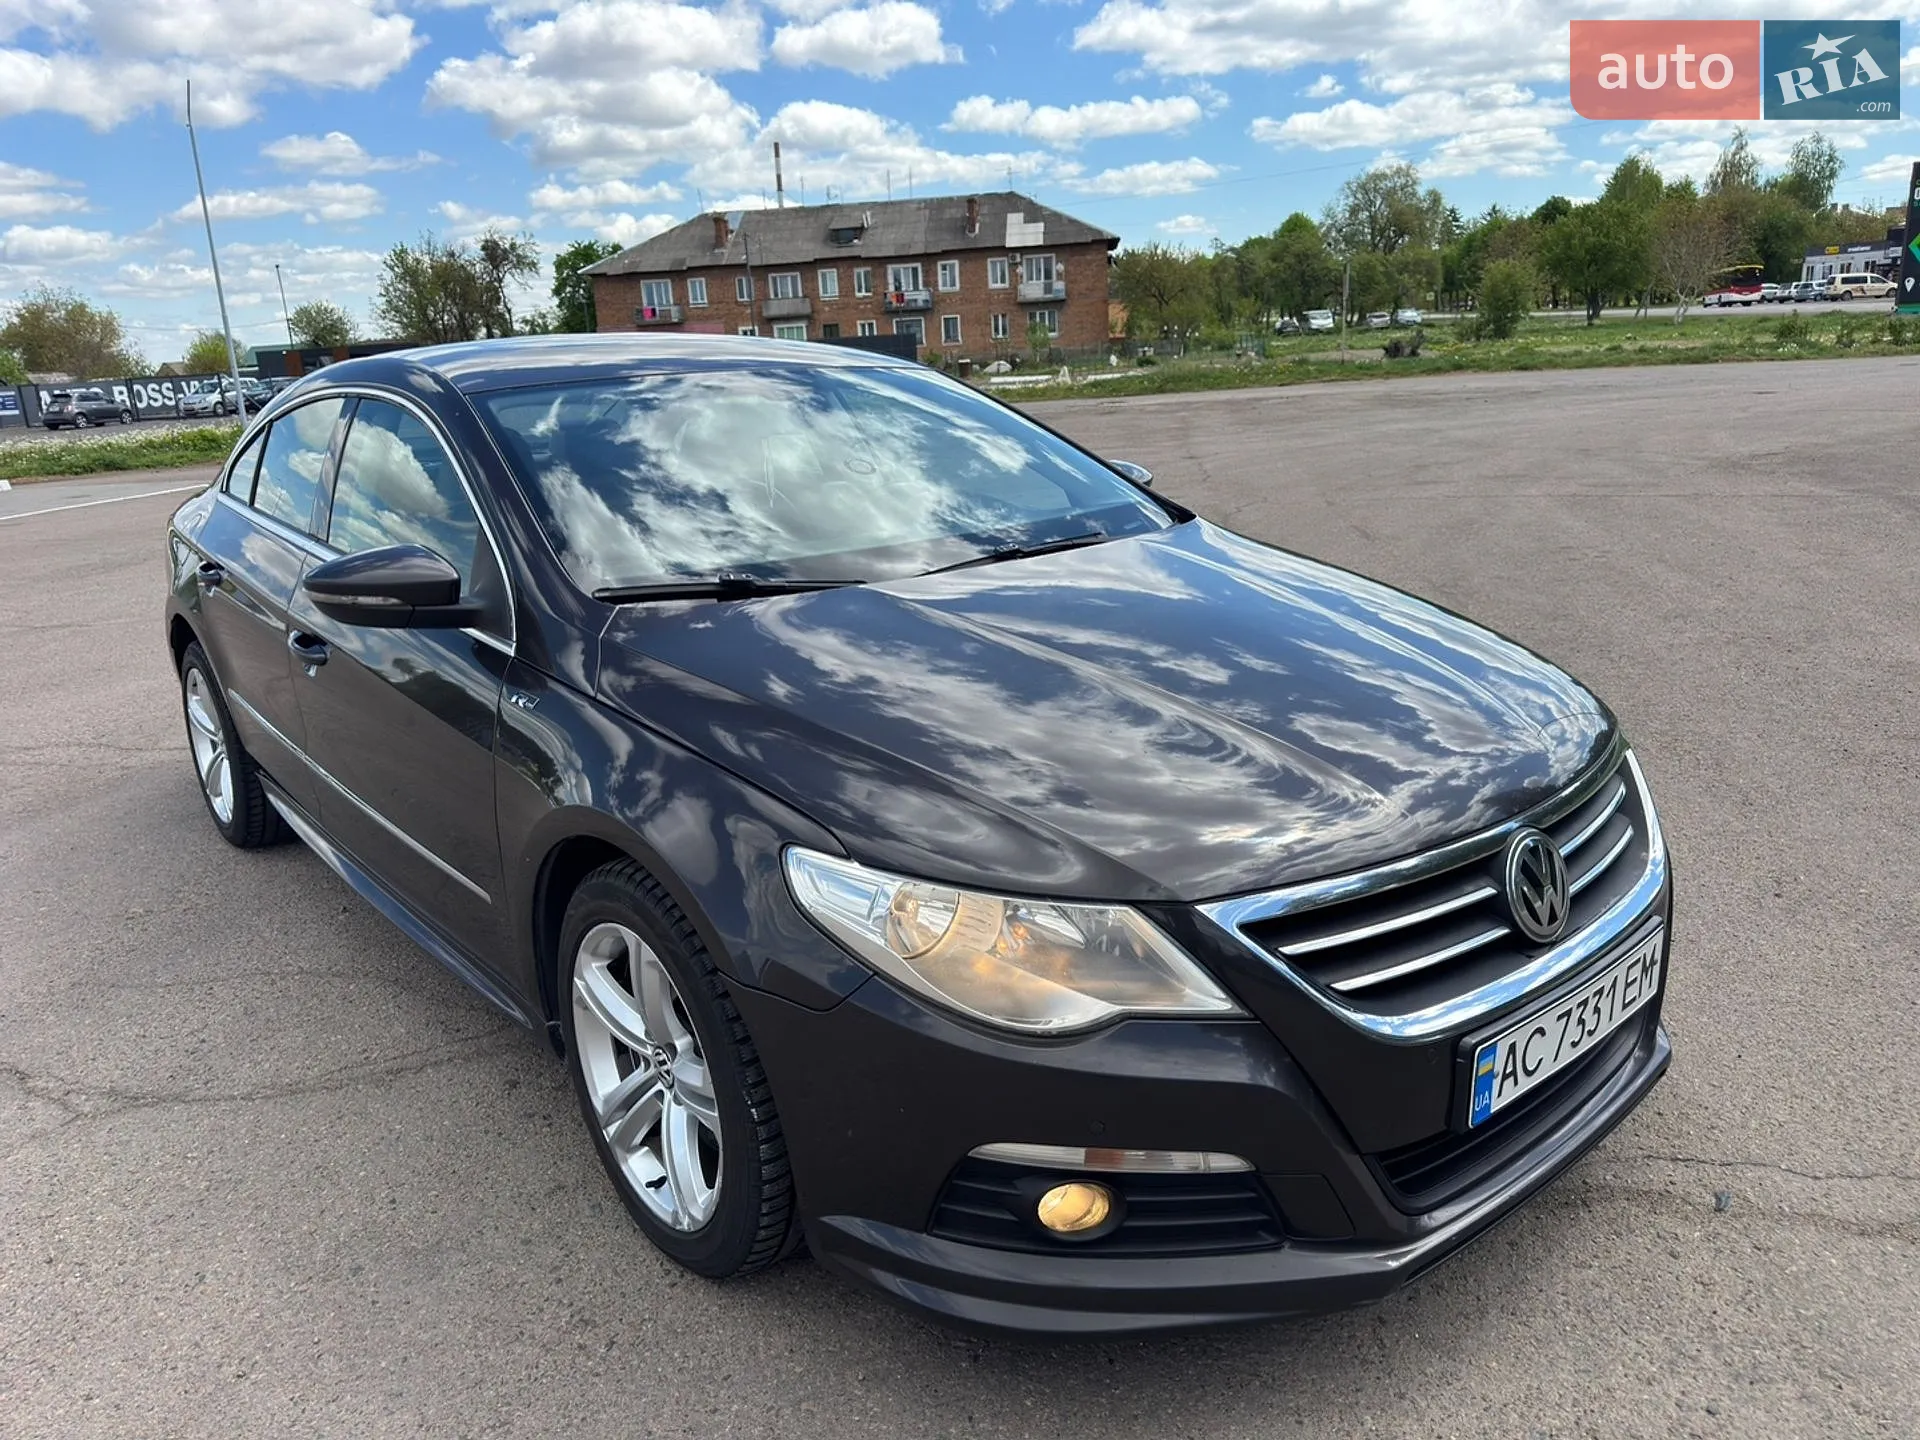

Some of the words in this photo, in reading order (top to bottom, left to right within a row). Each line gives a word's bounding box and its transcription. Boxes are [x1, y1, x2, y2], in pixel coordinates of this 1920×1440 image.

[1497, 1026, 1547, 1098] AC
[1553, 975, 1619, 1063] 7331
[1474, 1090, 1490, 1112] UA
